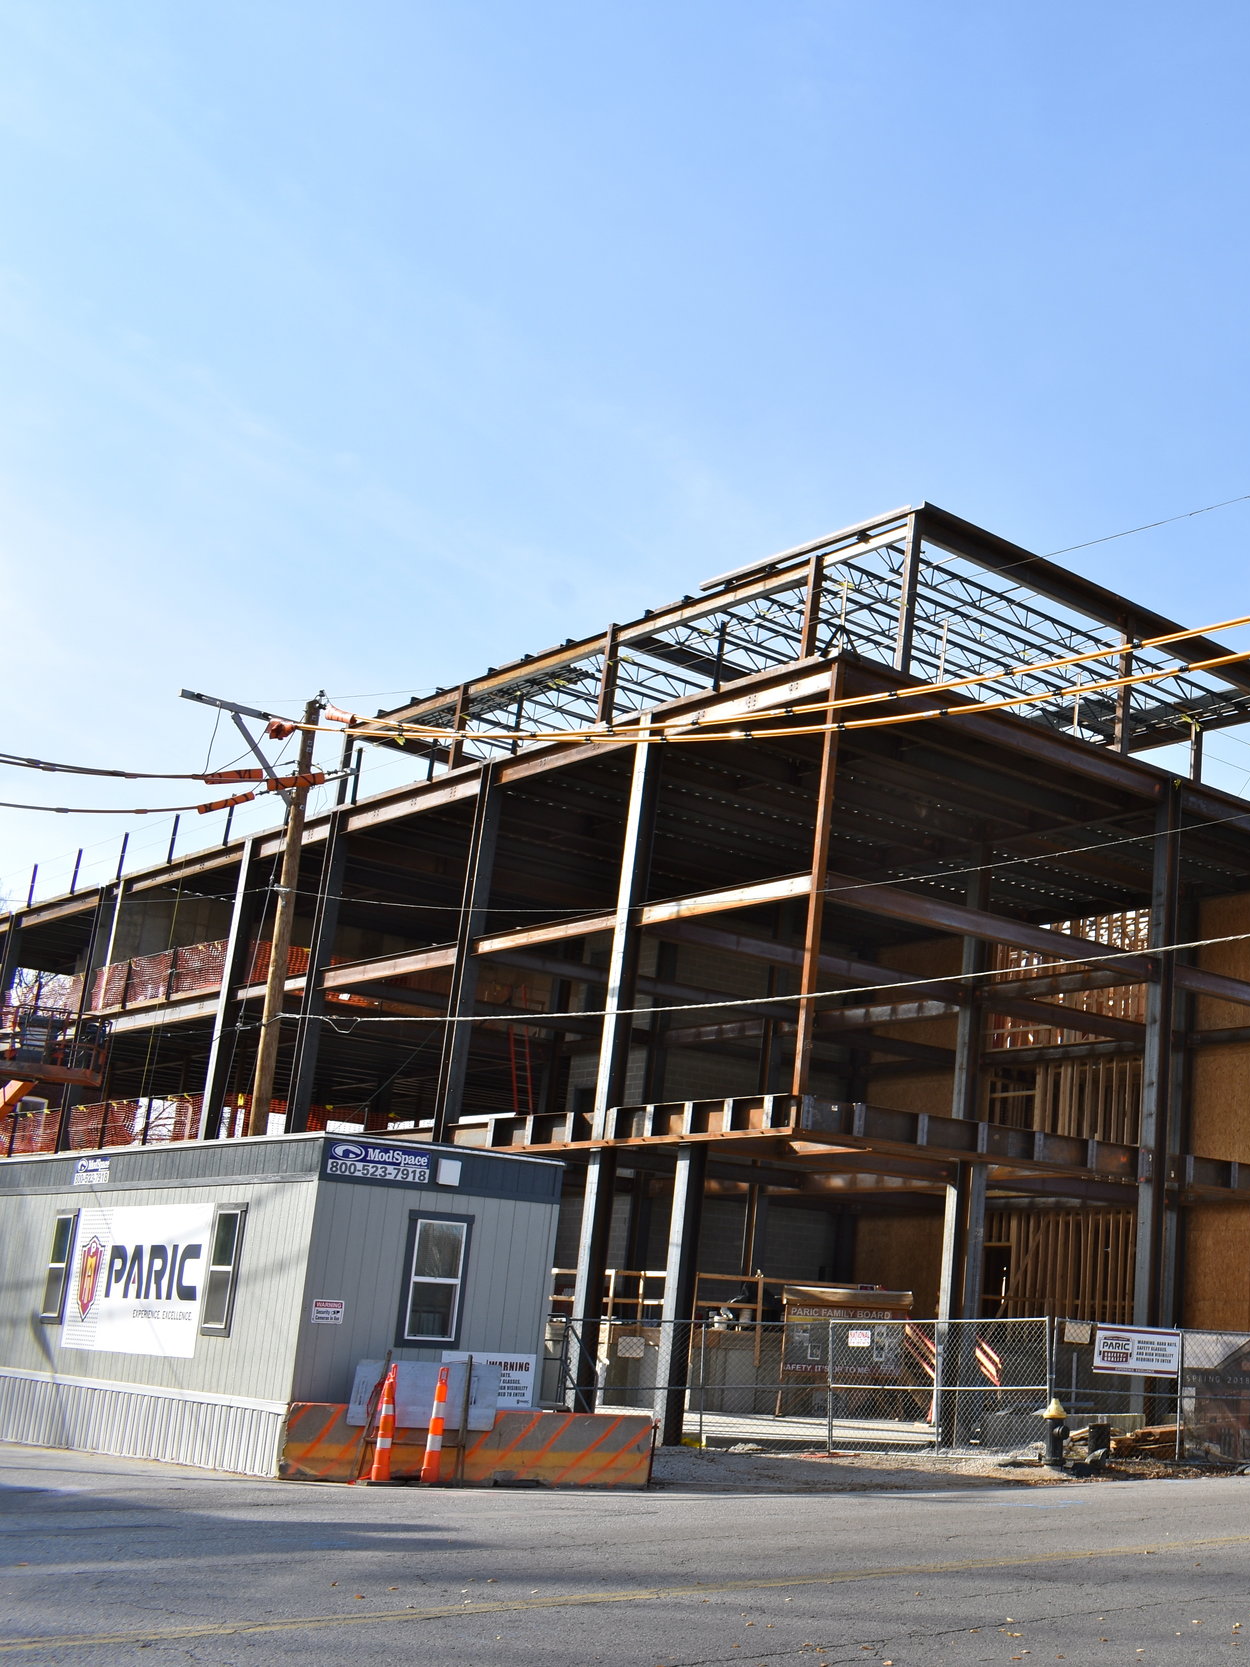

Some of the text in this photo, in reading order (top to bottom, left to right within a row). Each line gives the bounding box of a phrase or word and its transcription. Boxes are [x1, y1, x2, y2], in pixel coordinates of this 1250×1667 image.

[366, 1148, 428, 1166] ModSpace
[329, 1160, 427, 1182] 800-523-7918
[104, 1243, 203, 1301] PARIC
[791, 1307, 891, 1320] PARIC FAMILY BOARD
[1102, 1341, 1130, 1351] PARIC
[488, 1361, 531, 1373] ARNING
[1227, 1377, 1250, 1385] 2018
